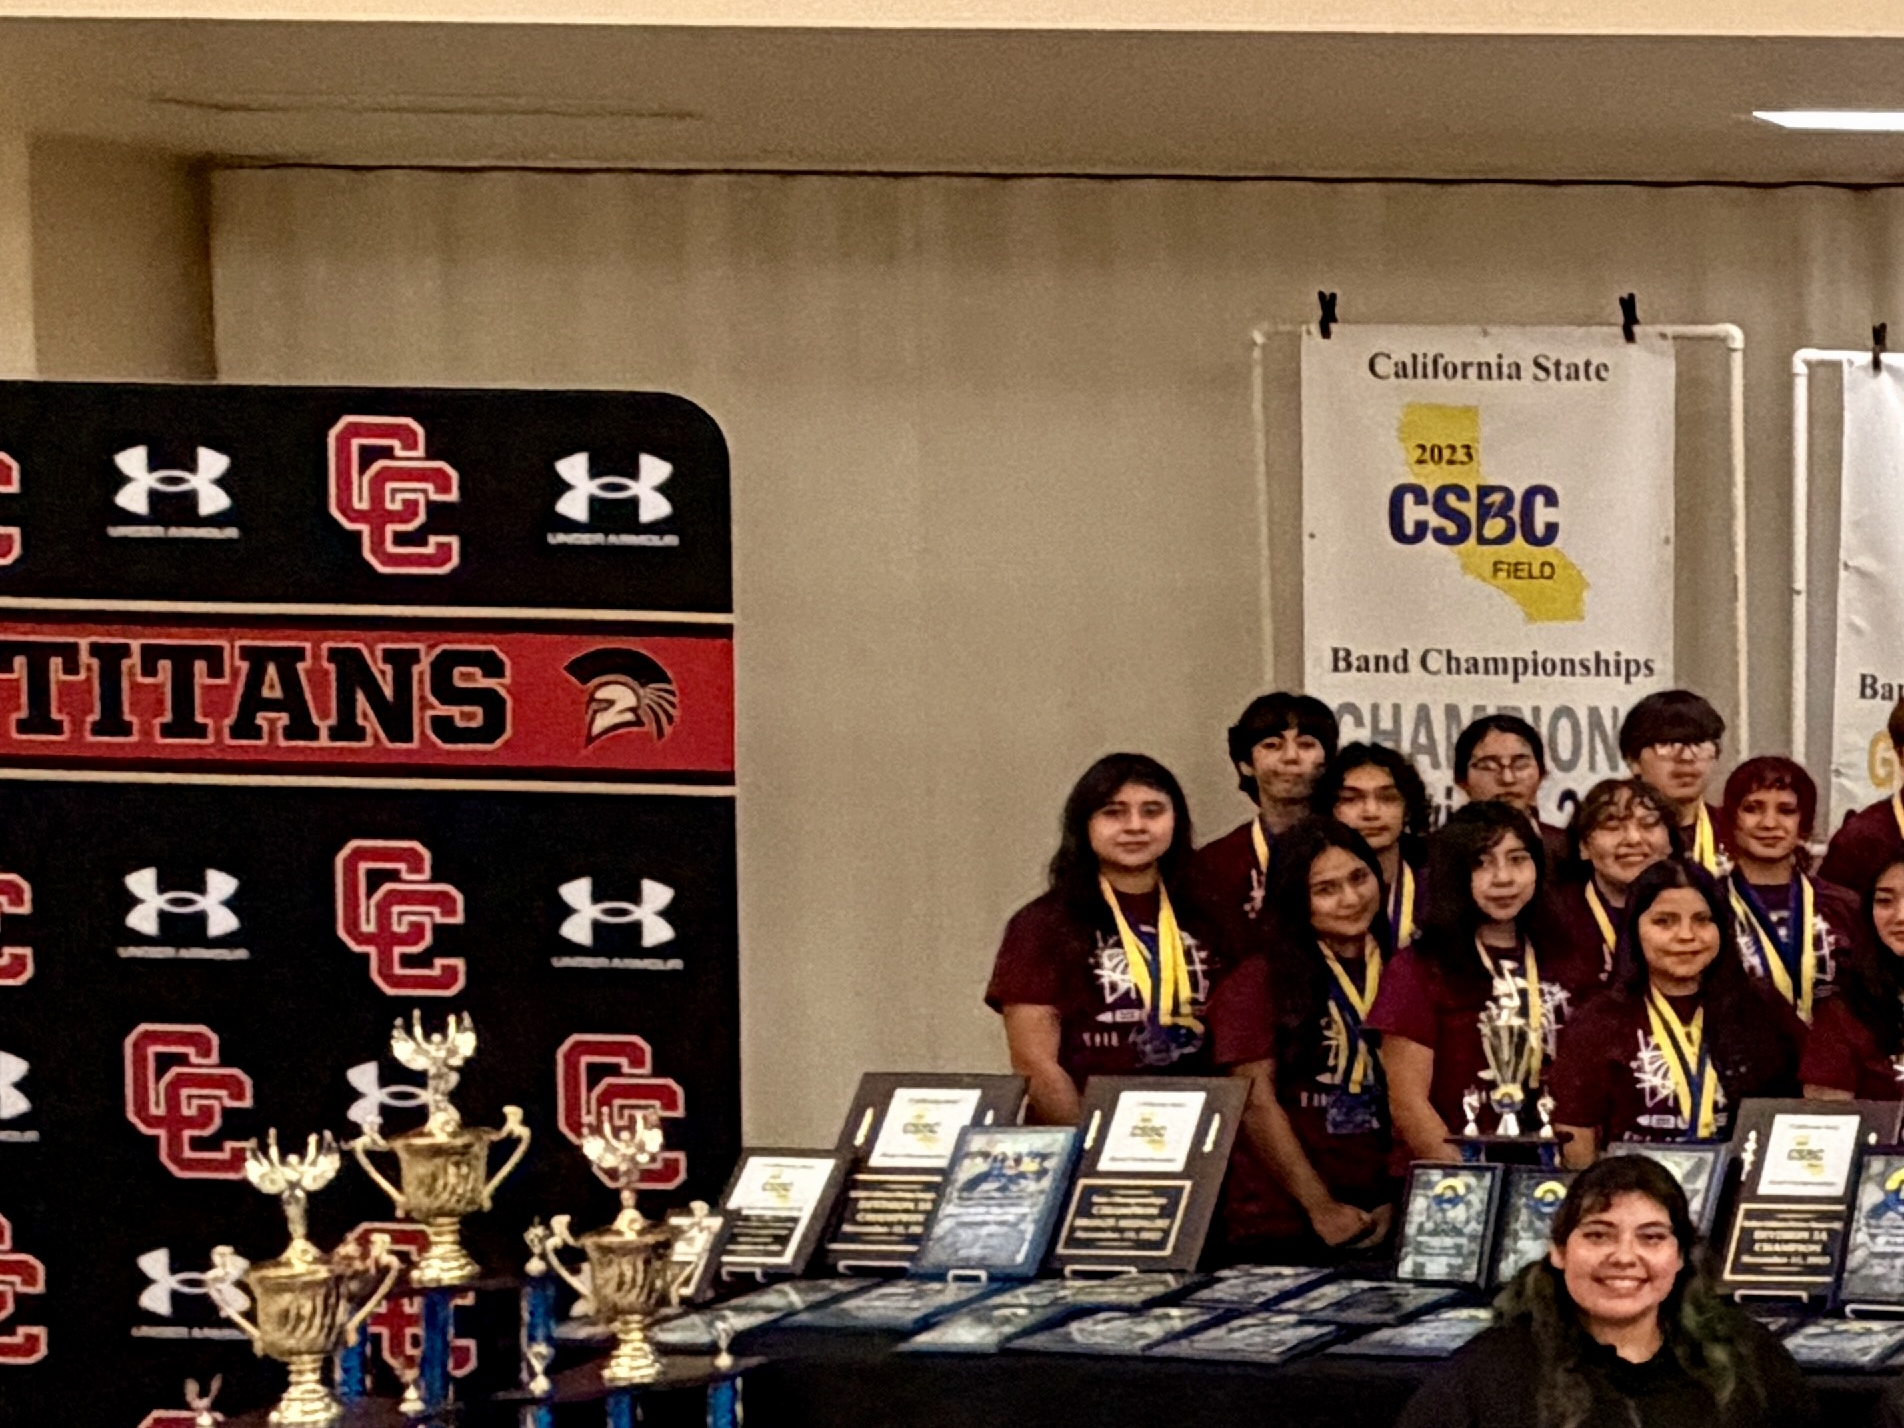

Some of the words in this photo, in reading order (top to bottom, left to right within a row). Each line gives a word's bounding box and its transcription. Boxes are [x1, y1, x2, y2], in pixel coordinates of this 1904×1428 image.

[1368, 353, 1522, 381] California
[1532, 355, 1610, 382] State
[1413, 445, 1474, 465] 2023
[327, 414, 461, 575] CC
[1389, 483, 1560, 547] CSBC
[1492, 560, 1556, 580] FIELD
[1331, 646, 1410, 674] Band
[1420, 648, 1655, 684] Championships
[0, 639, 512, 750] TITANS
[334, 839, 467, 996] CC
